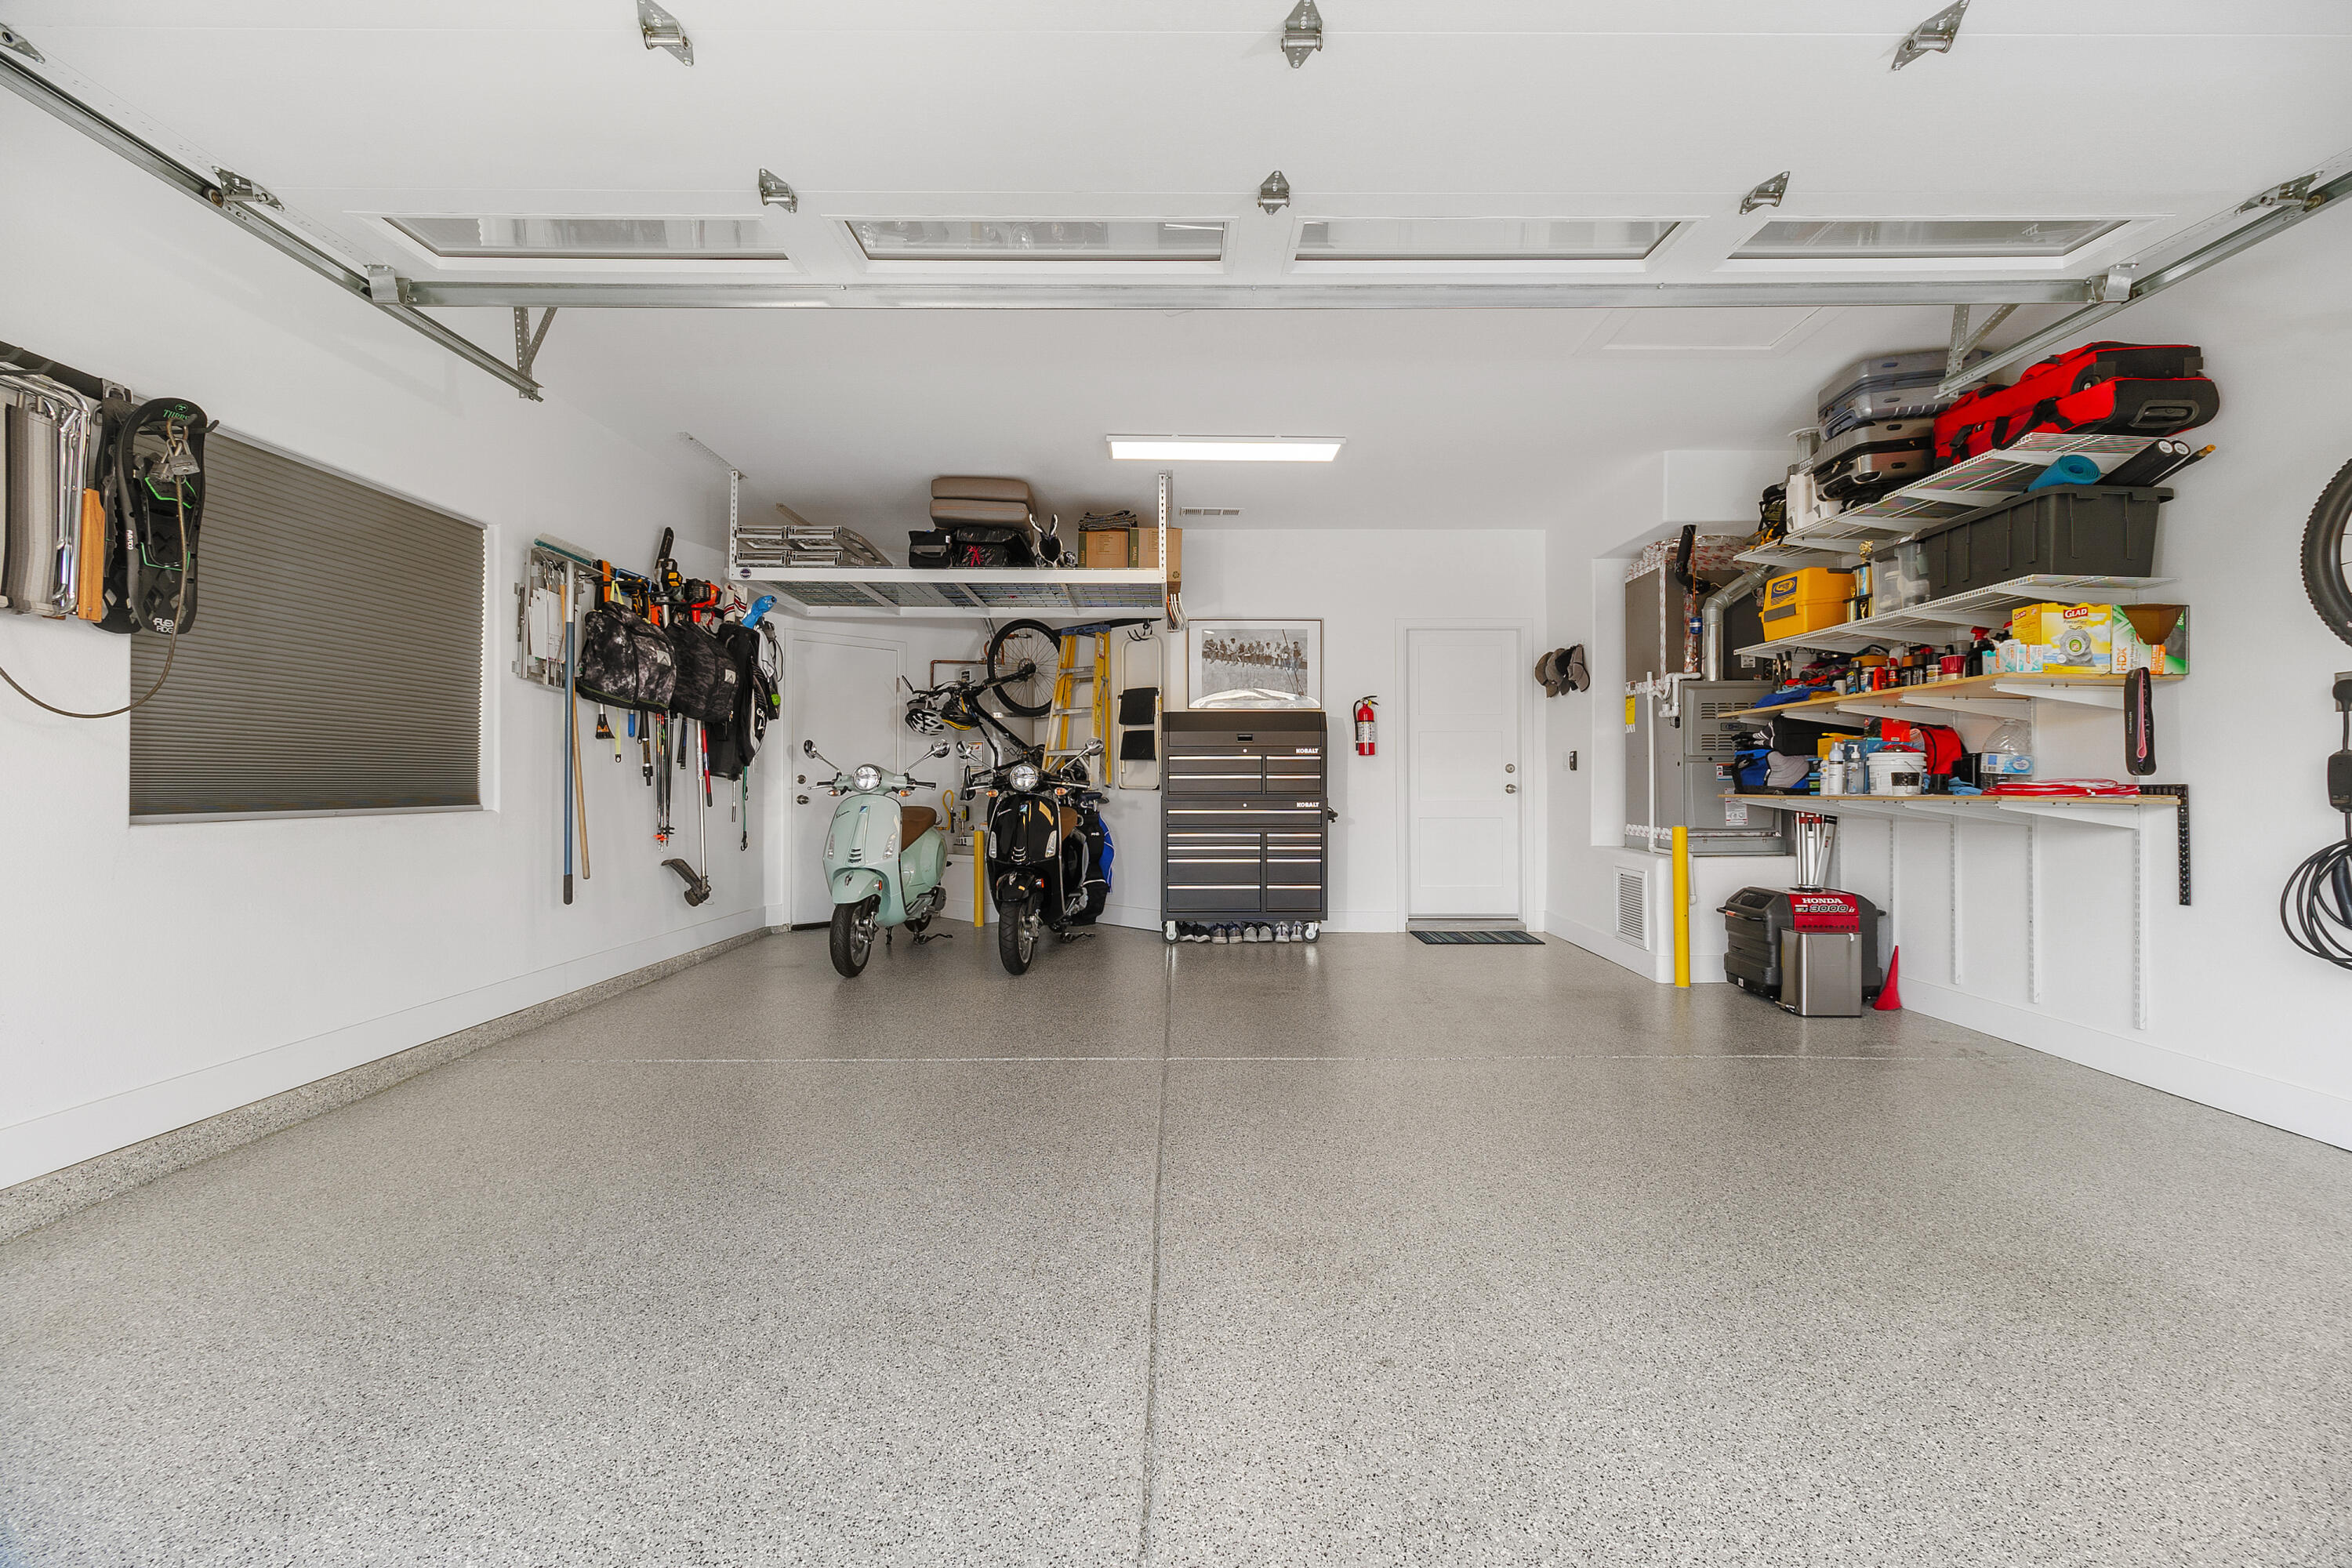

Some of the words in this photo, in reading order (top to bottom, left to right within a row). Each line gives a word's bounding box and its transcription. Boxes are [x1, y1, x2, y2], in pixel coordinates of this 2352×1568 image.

[2064, 608, 2087, 618] GLAD
[2117, 647, 2127, 671] HDX
[1809, 904, 1849, 913] 3000
